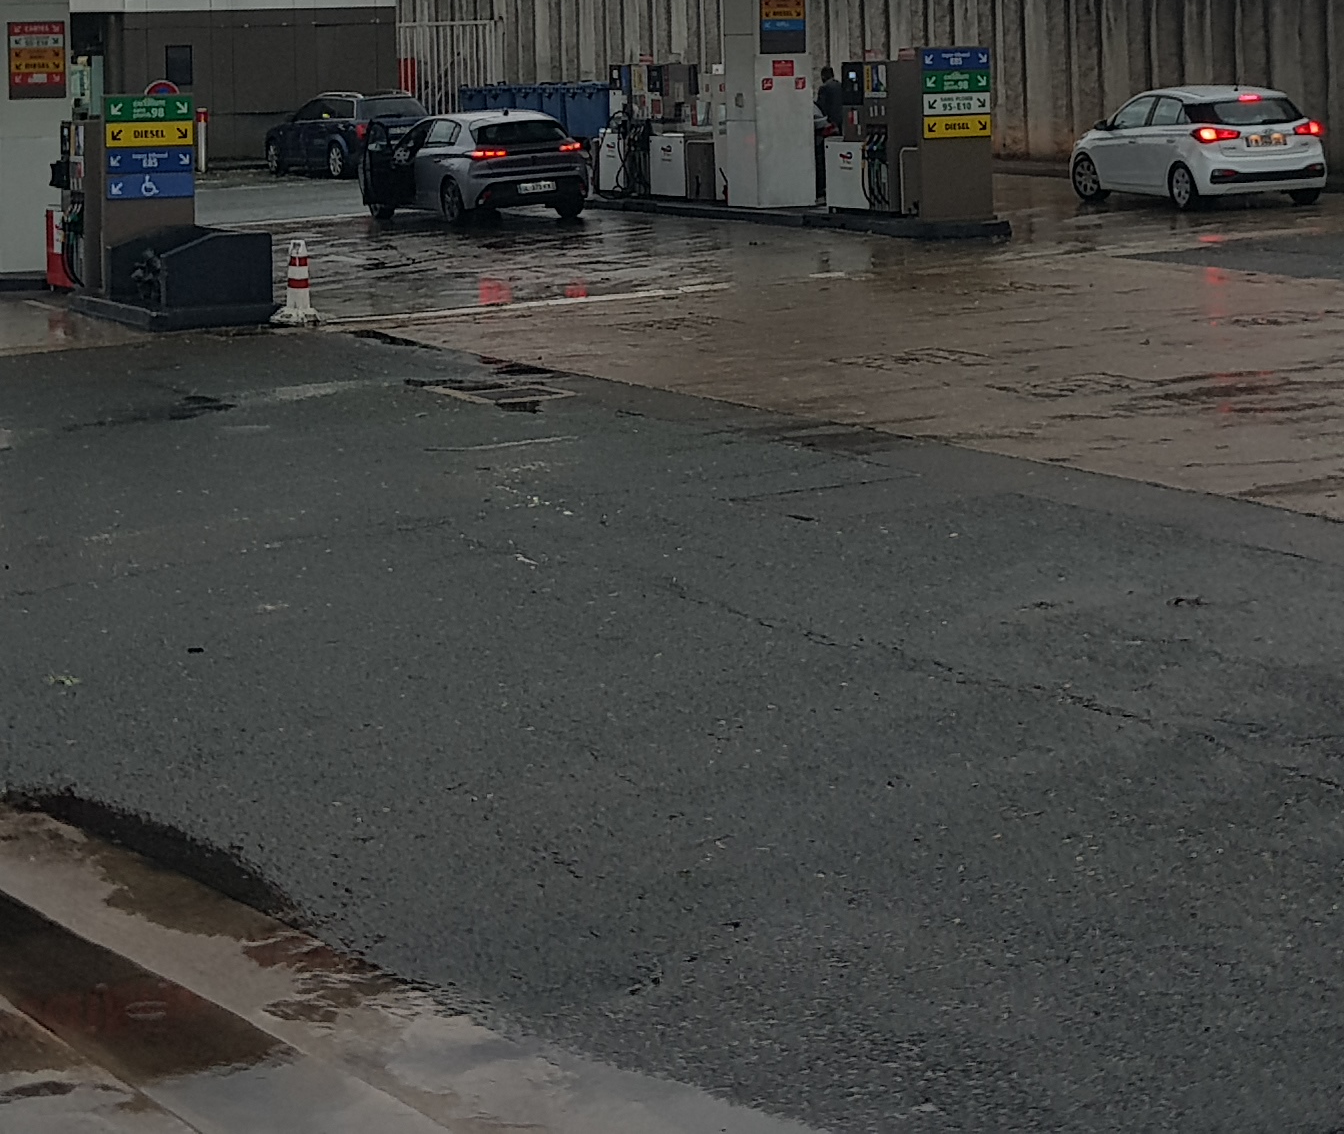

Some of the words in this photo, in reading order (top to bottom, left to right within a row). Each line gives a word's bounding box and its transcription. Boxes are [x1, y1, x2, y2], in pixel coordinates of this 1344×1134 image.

[942, 102, 972, 112] 95-E10
[151, 107, 165, 119] 98
[944, 122, 970, 131] DIESEL
[133, 129, 166, 139] DIESEL
